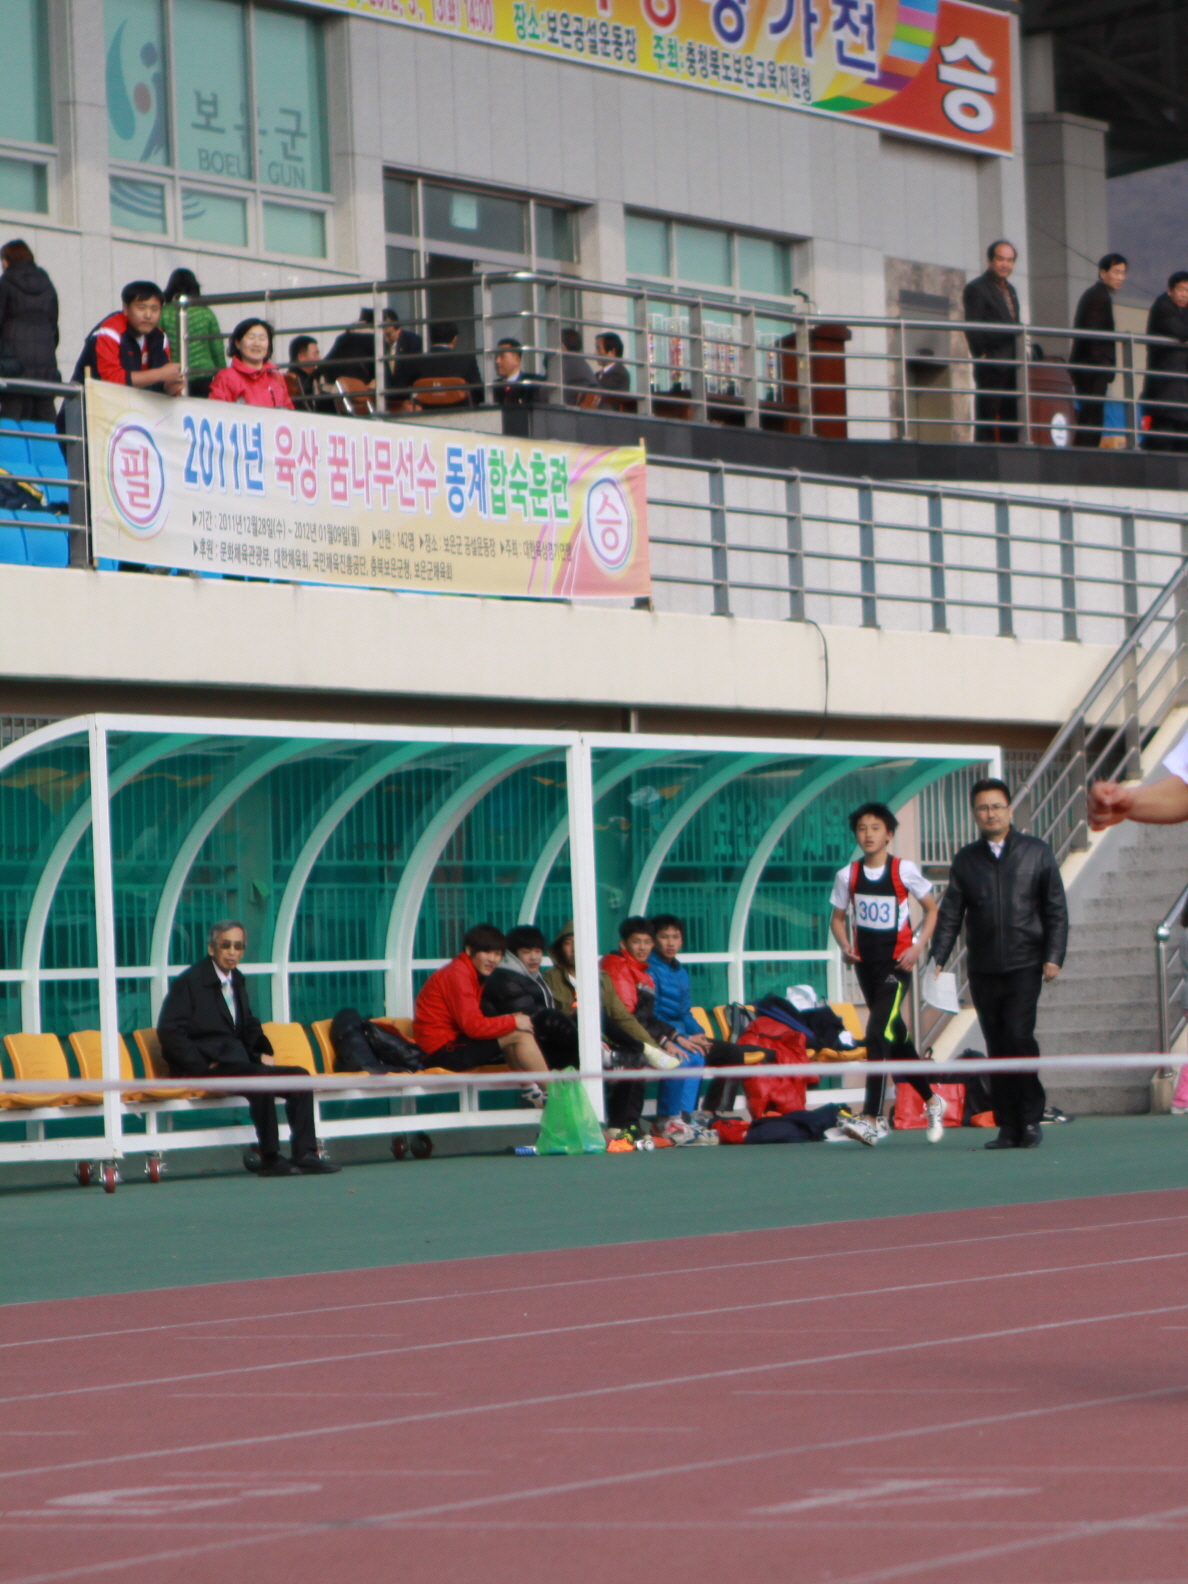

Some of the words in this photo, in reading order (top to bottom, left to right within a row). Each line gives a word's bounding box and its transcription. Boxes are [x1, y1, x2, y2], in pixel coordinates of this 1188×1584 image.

[937, 36, 997, 132] 승
[268, 160, 305, 188] GUN
[118, 444, 151, 510] 필
[183, 415, 264, 491] 2011년
[274, 425, 319, 500] 육상
[328, 433, 437, 511] 꿈나무선수
[595, 490, 622, 552] 승
[859, 901, 890, 923] 303
